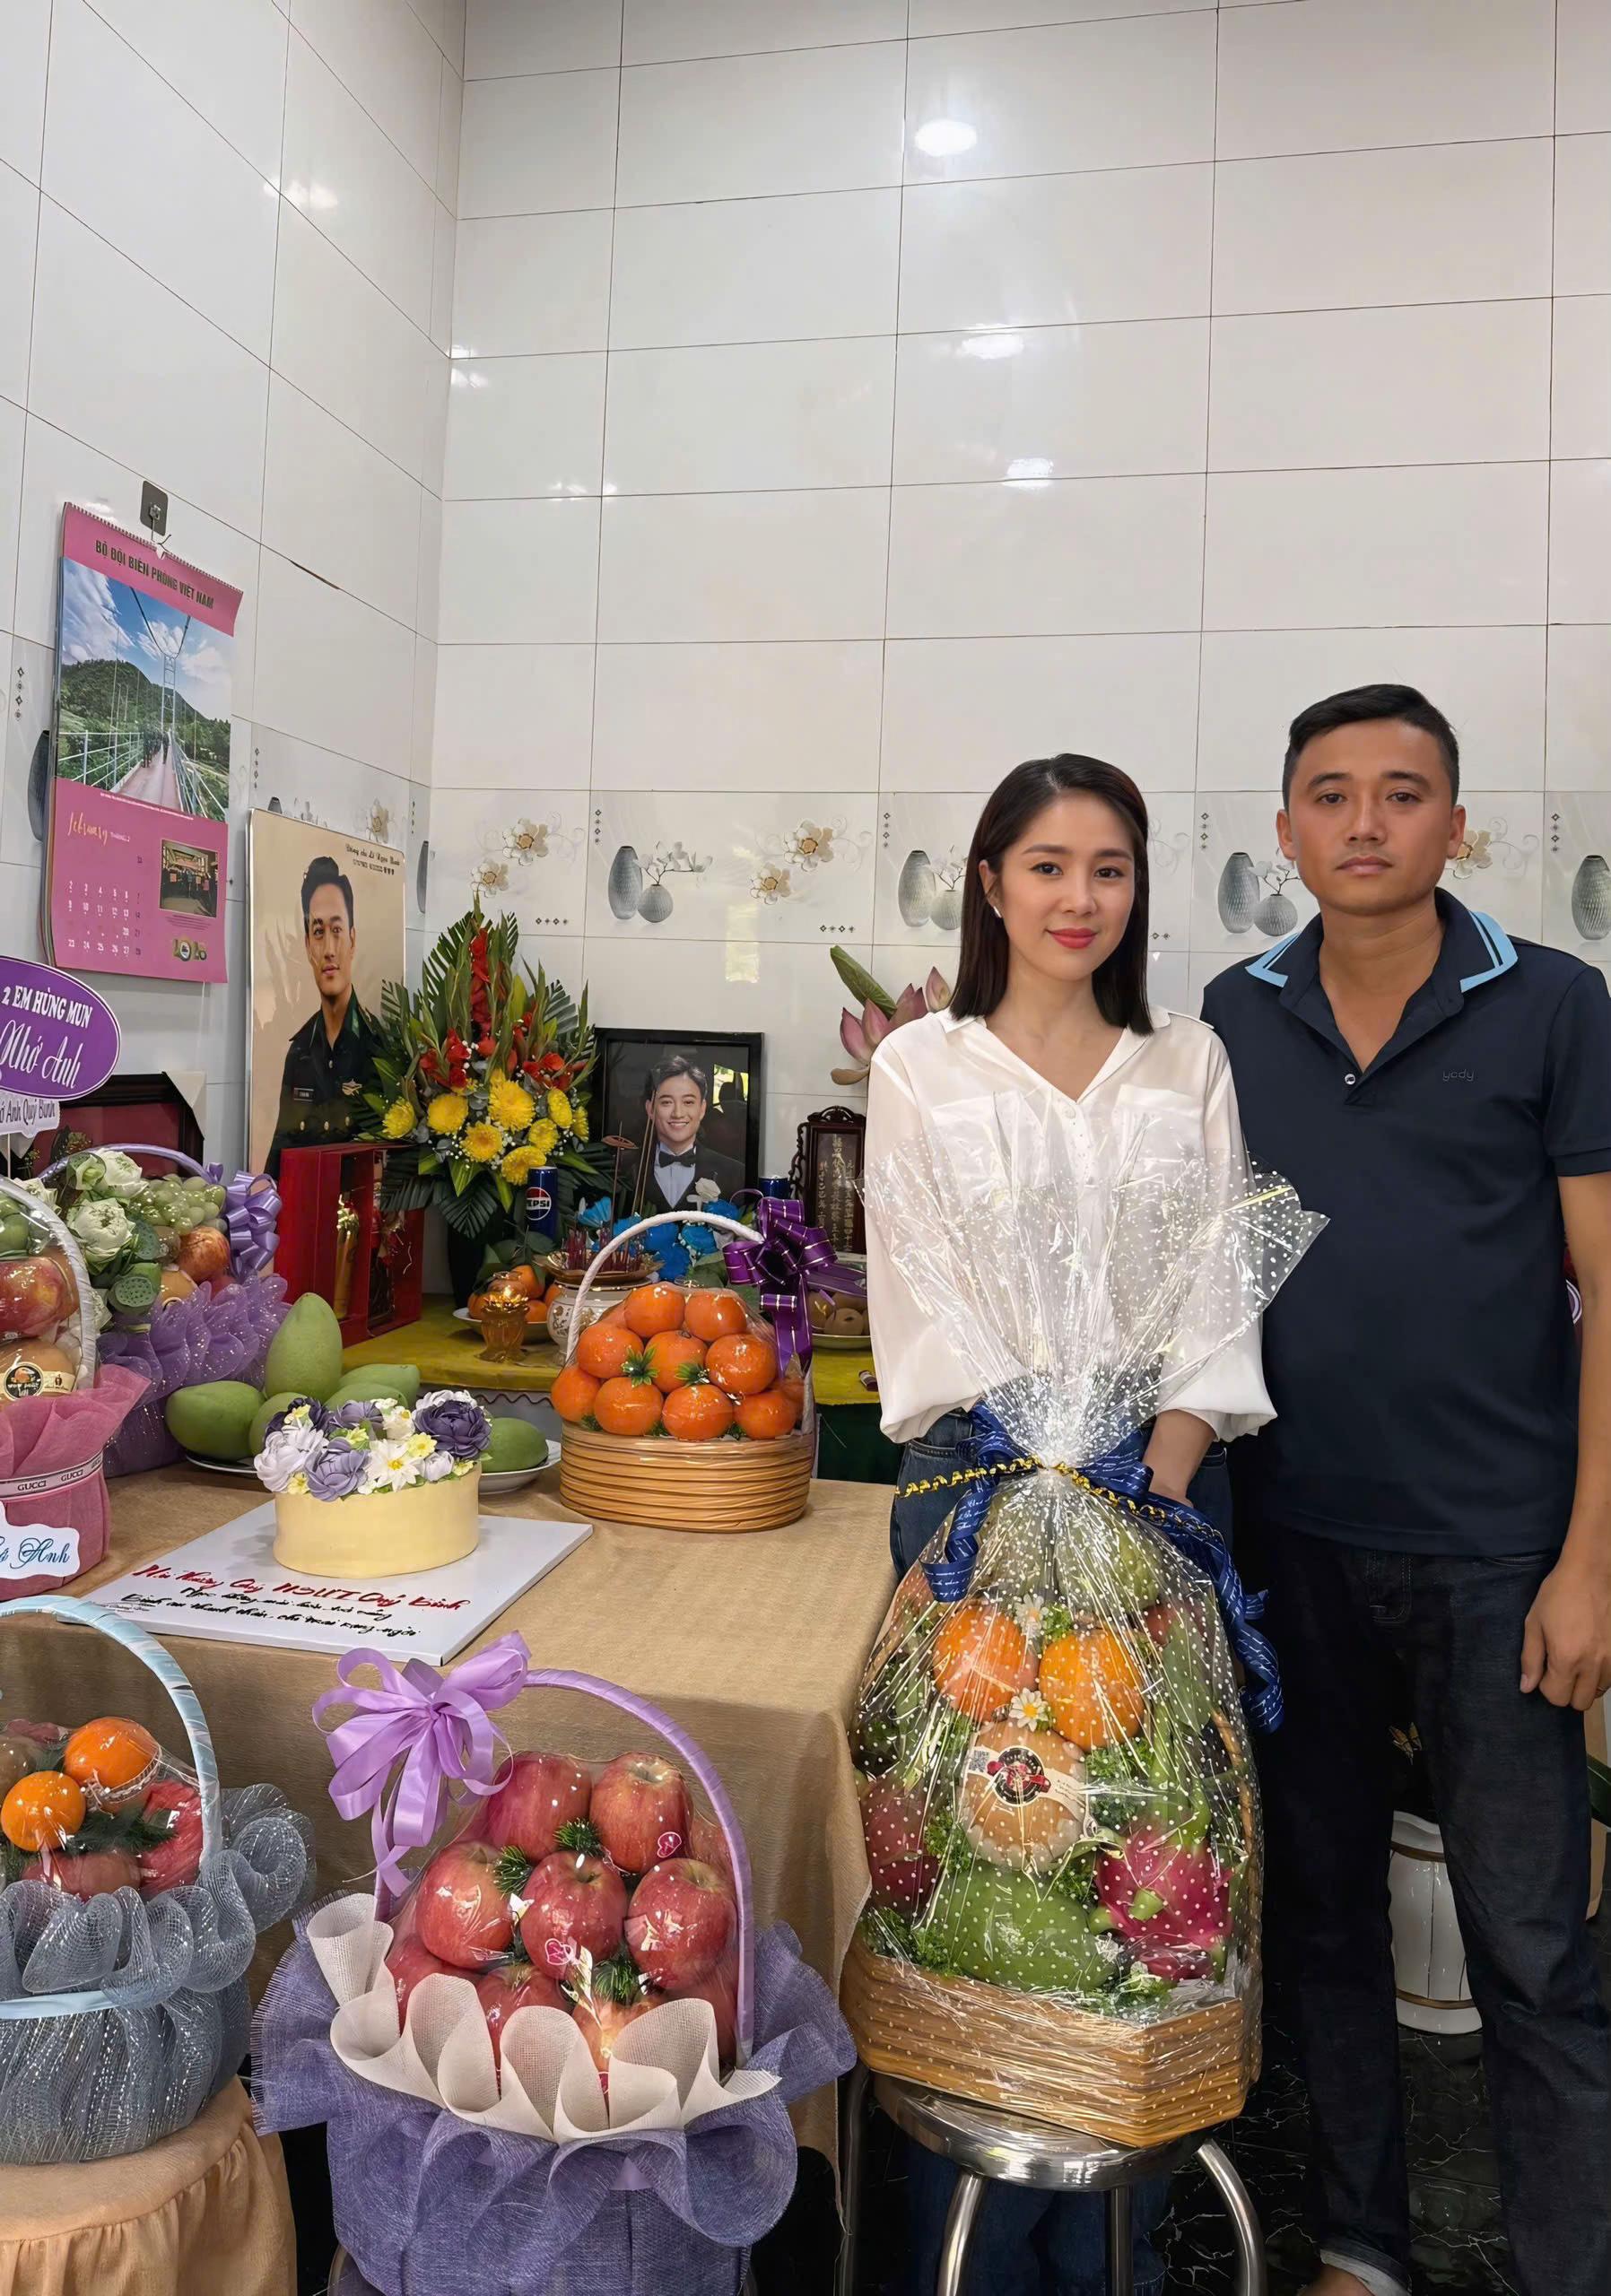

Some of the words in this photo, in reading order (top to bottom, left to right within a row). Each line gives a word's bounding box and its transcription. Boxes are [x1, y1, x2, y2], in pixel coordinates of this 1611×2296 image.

[196, 591, 214, 609] NAM
[2, 987, 11, 1005] 2
[12, 985, 31, 1013] EM
[31, 987, 67, 1022] HÙNG
[65, 1000, 93, 1030] MUN
[0, 1019, 43, 1074] Nhớ
[42, 1036, 83, 1089] Anh
[18, 1480, 47, 1492] GUCCI
[60, 1469, 83, 1483] GUCCI
[10, 1537, 71, 1569] Anh
